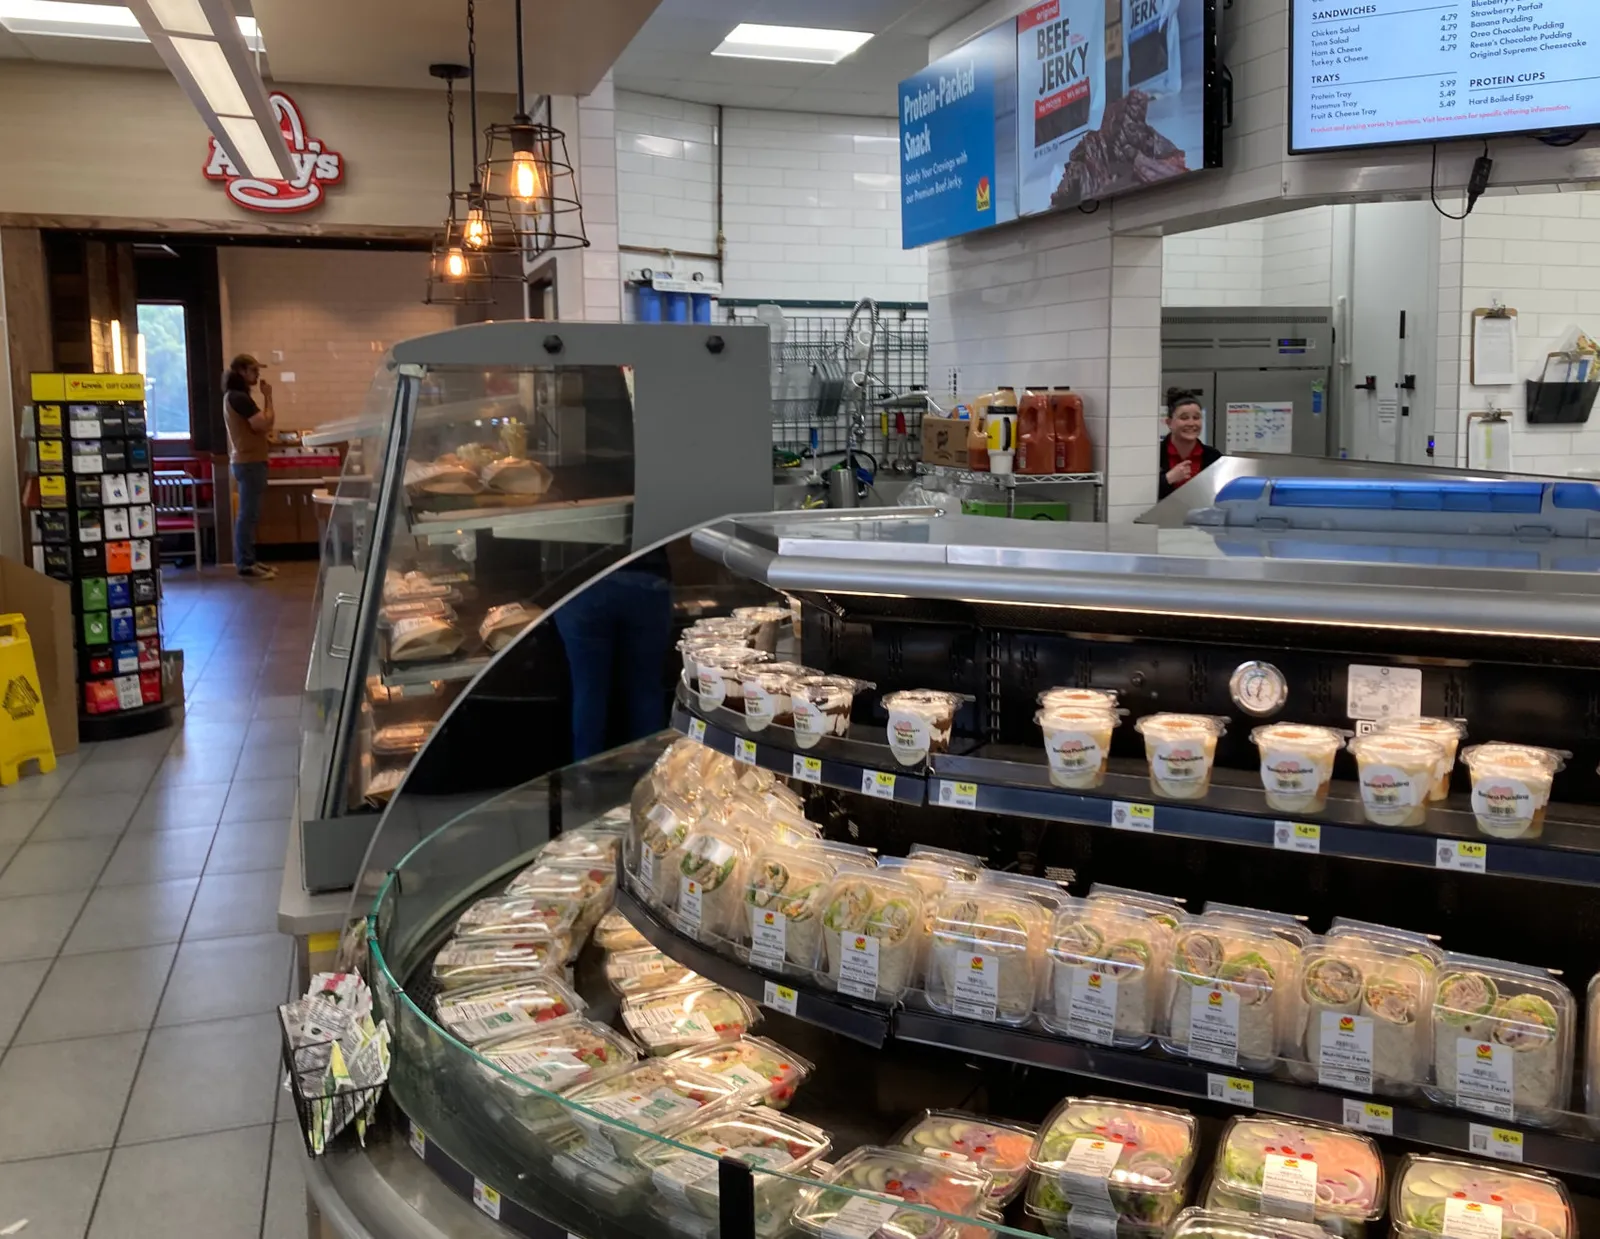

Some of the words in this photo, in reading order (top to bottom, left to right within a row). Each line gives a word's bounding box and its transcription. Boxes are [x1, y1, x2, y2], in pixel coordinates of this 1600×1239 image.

[1312, 5, 1377, 20] SANDWICHES
[1471, 7, 1515, 17] Strawberry
[1517, 2, 1543, 11] Parfait
[1440, 13, 1458, 21] 4.79
[1471, 19, 1500, 28] Banana
[1502, 14, 1533, 24] Pudding
[1311, 26, 1338, 38] Chicken
[1340, 25, 1360, 35] Salad
[1440, 23, 1458, 32] 4.79
[1470, 30, 1491, 38] Oreo
[1493, 26, 1530, 35] Chocolate
[1533, 21, 1564, 30] Pudding
[1037, 18, 1069, 60] BEEF
[1311, 39, 1328, 47] Tuna
[1329, 36, 1349, 45] Salad
[1440, 33, 1458, 42] 4.79
[1470, 40, 1498, 48] Reese's
[1500, 36, 1538, 45] Chocolate
[1540, 31, 1572, 40] Pudding
[1311, 49, 1328, 57] Ham
[1330, 47, 1335, 55] &
[1440, 44, 1457, 52] 4.79
[1470, 50, 1501, 59] Original
[1503, 46, 1537, 55] Supreme
[1540, 40, 1587, 51] Cheesecake
[1311, 58, 1334, 67] Turkey
[1343, 54, 1369, 63] Cheese
[1039, 42, 1089, 95] JERKY
[1312, 73, 1340, 83] TRAYS
[1440, 79, 1457, 88] 5.99
[1470, 75, 1514, 87] PROTEIN
[1517, 72, 1545, 82] CUPS
[904, 59, 974, 125] Protein-Packed
[1311, 92, 1335, 101] Protein
[1336, 91, 1352, 99] Tray
[1439, 90, 1456, 98] 5.49
[1311, 102, 1340, 110] Hummus
[1342, 100, 1358, 108] Tray
[1439, 100, 1456, 108] 5.49
[1469, 97, 1488, 106] Hard
[1490, 95, 1514, 104] Boiled
[1516, 93, 1534, 102] Eggs
[1334, 110, 1360, 118] Cheese
[1361, 108, 1377, 116] Tray
[904, 122, 931, 161] Snack
[206, 139, 340, 188] Ay's
[921, 166, 932, 180] Your
[933, 158, 956, 173] Cravings
[956, 149, 968, 165] with
[906, 194, 914, 204] our
[914, 184, 935, 201] Premium
[935, 177, 947, 193] Beef
[1323, 1051, 1350, 1060] Nutrition
[1459, 1079, 1489, 1089] Nutrition
[1491, 1084, 1510, 1093] Facts
